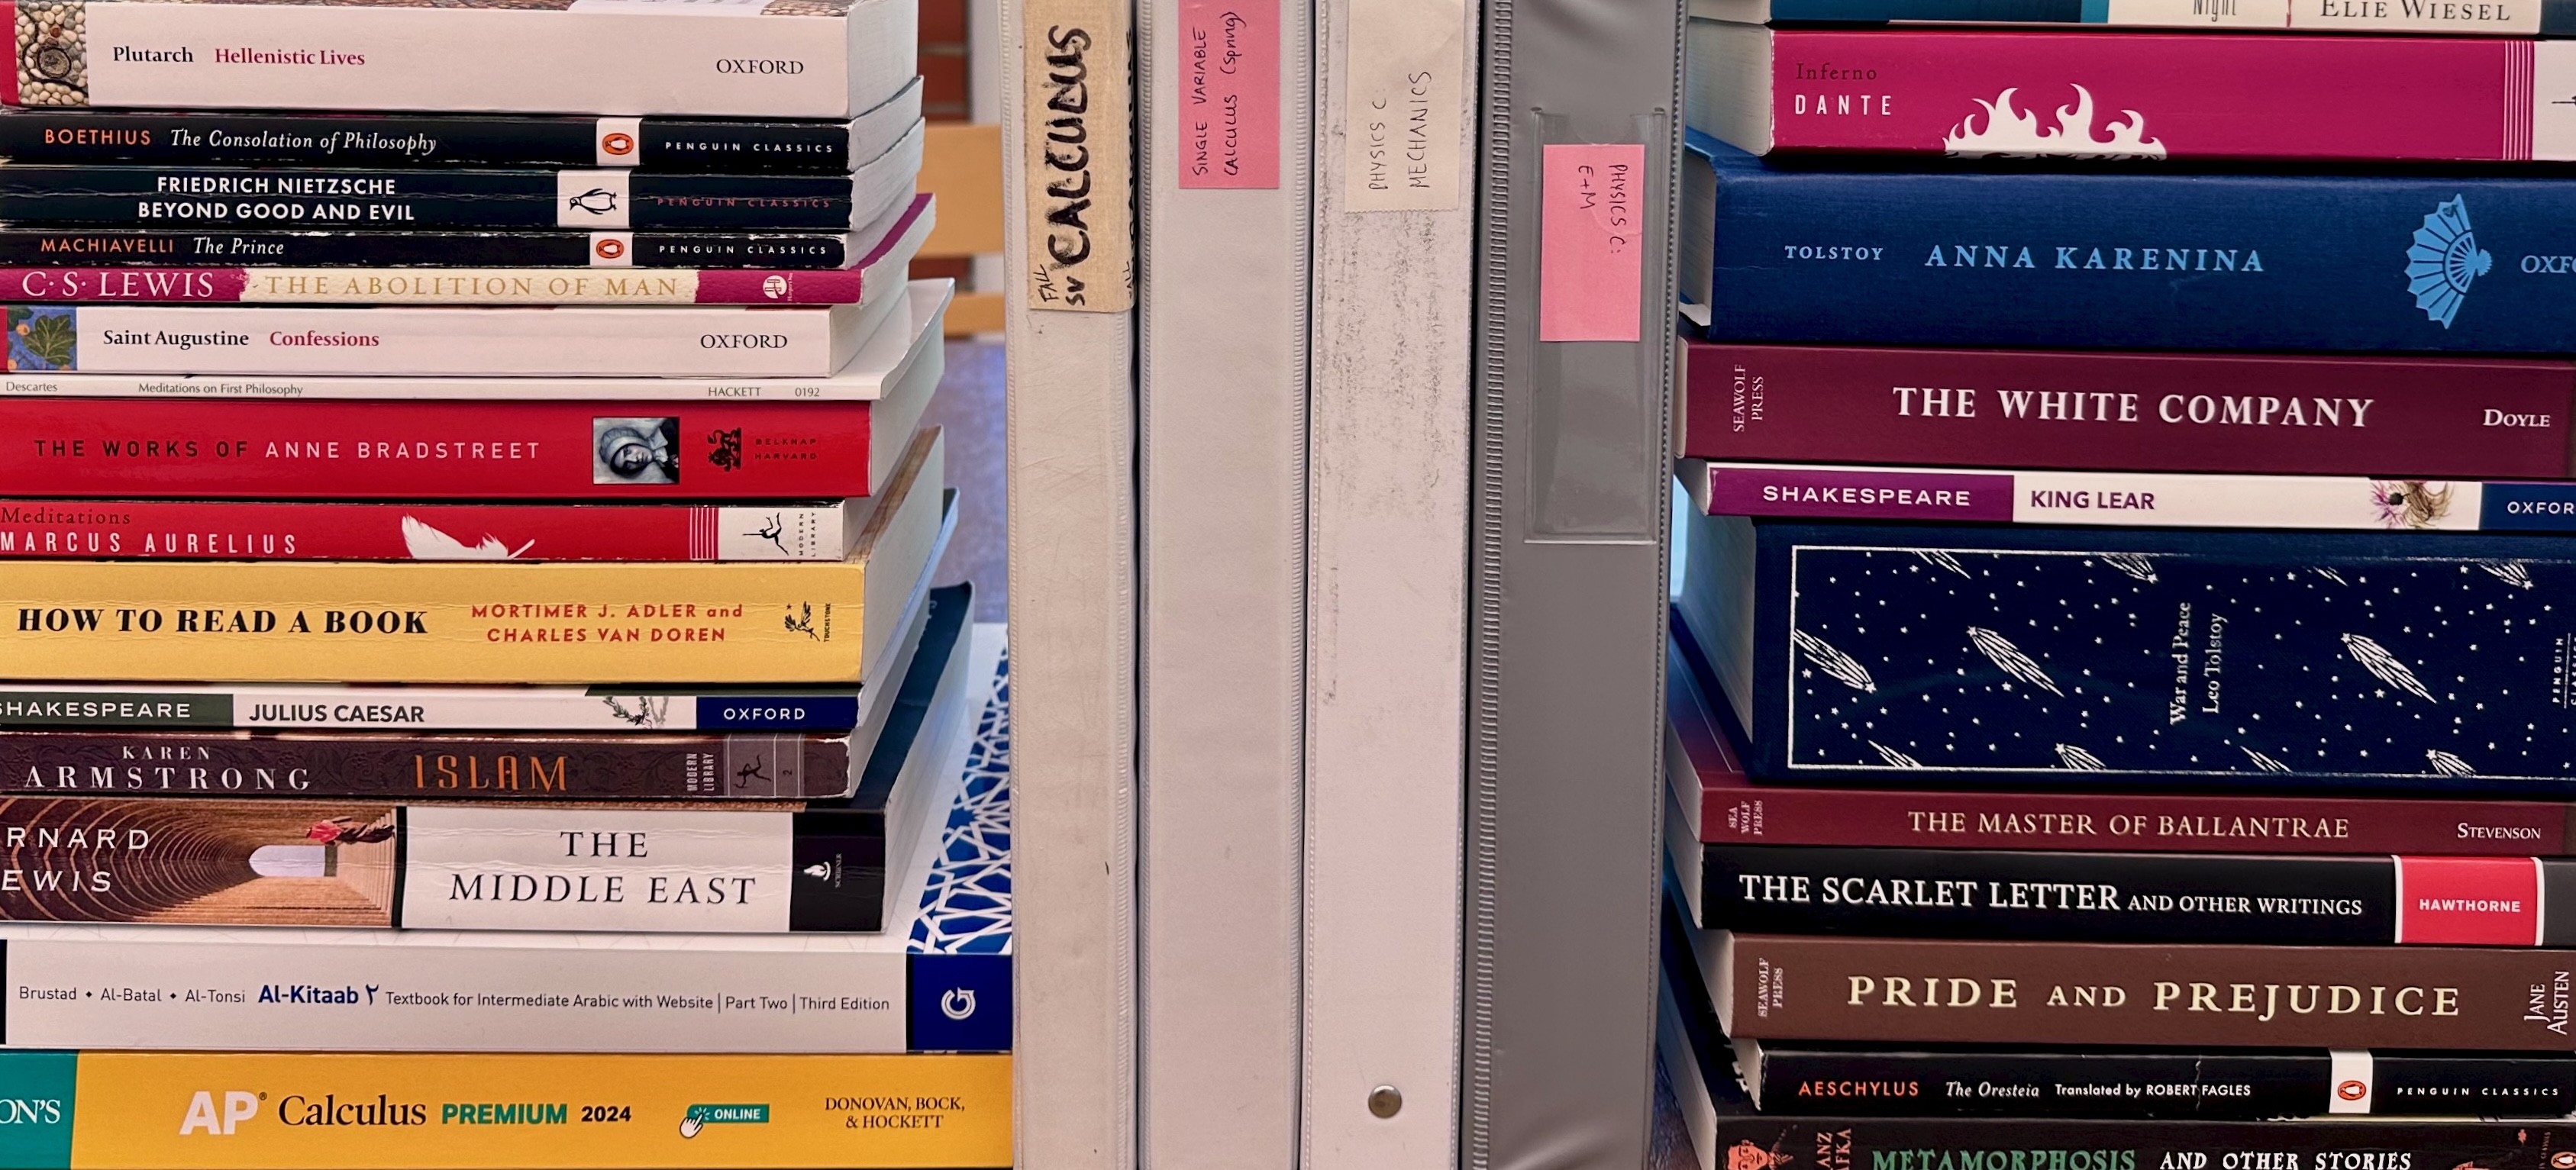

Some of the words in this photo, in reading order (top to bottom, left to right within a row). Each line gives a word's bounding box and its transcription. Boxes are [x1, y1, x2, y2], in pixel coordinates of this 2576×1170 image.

[2401, 0, 2510, 20] WIESEL
[113, 47, 194, 63] Plutarch
[215, 48, 316, 66] Hellenistic
[320, 50, 366, 66] Lives
[1192, 27, 1206, 104] VARIABLE
[1796, 63, 1877, 80] Inferno
[1795, 95, 1892, 115] DANTE
[45, 130, 150, 144] BOETHIUS
[1225, 95, 1238, 176] CALCULUS
[1406, 72, 1432, 188] MECHANICS
[172, 130, 201, 147] The
[209, 131, 312, 148] Consolation
[320, 131, 338, 153] of
[344, 132, 437, 155] Philosophy
[666, 142, 741, 150] PENGUIN
[754, 143, 833, 153] CLASSICS
[1045, 25, 1091, 269] CALCULUS
[1193, 122, 1208, 176] SINGLE
[1369, 122, 1388, 189] PHYSICS
[158, 177, 269, 194] FRIEDRICH
[278, 179, 395, 195] NIETZSCHE
[1609, 165, 1628, 226] PHYSICS
[138, 202, 228, 218] BEYOND
[236, 203, 304, 219] GOOD
[312, 205, 360, 219] AND
[370, 205, 414, 221] EVIL
[657, 198, 735, 207] PENGUIN
[748, 199, 831, 208] CLASSICS
[41, 239, 173, 253] MACHIAVELLI
[194, 237, 224, 254] The
[231, 239, 284, 255] Prince
[1785, 246, 1884, 260] TOLSTOY
[1925, 246, 2035, 269] ANNA
[2055, 247, 2264, 271] KARENINA
[99, 272, 214, 297] LEWIS
[265, 276, 328, 294] THE
[344, 276, 532, 295] ABOLITION
[548, 278, 586, 295] OF
[606, 278, 676, 295] MAN
[1033, 264, 1057, 302] FALL
[103, 330, 150, 346] Saint
[155, 330, 249, 350] Augustine
[270, 331, 379, 347] Confessions
[6, 381, 57, 393] Descartes
[138, 384, 200, 395] Meditations
[204, 385, 218, 394] on
[221, 384, 242, 395] First
[246, 384, 303, 397] Philosophy
[709, 387, 761, 397] HACKETT
[795, 387, 819, 397] 0192
[1733, 364, 1745, 432] SEAWOLF
[1751, 376, 1763, 421] PRESS
[1893, 386, 1976, 417] THE
[1997, 390, 2138, 422] WHITE
[2159, 395, 2374, 427] COMPANY
[34, 440, 85, 457] THE
[103, 440, 199, 457] WORKS
[216, 441, 248, 457] OF
[266, 441, 339, 458] ANNE
[358, 442, 539, 458] BRADSTREET
[1763, 485, 1970, 506] SHAKESPEARE
[2031, 490, 2089, 509] KING
[2098, 492, 2155, 510] LEAR
[1, 507, 131, 524] Meditations
[1, 531, 120, 552] MARCUS
[145, 533, 296, 554] AURELIUS
[18, 609, 104, 631] HOW
[116, 610, 163, 632] TO
[176, 610, 276, 633] READ
[288, 611, 309, 633] A
[324, 611, 428, 633] BOOK
[472, 604, 587, 618] MORTIMER
[597, 604, 615, 618] J.
[627, 605, 696, 618] ADLER
[707, 604, 743, 617] and
[487, 629, 587, 642] CHARLES
[597, 628, 641, 642] VAN
[651, 629, 725, 642] DOREN
[2172, 602, 2191, 649] Peace
[2203, 613, 2229, 677] Tolstoy
[2171, 653, 2188, 683] and
[2552, 638, 2564, 703] PENGUIN
[2170, 686, 2187, 725] War
[2202, 680, 2220, 714] Leo
[250, 704, 328, 722] JULIUS
[334, 705, 424, 723] CAESAR
[723, 707, 805, 720] OXFORD
[686, 753, 697, 791] MODERN
[702, 753, 715, 791] LIBRARY
[1729, 807, 1738, 828] SEA
[1741, 801, 1750, 833] WOLF
[1754, 801, 1763, 835] PRESS
[1908, 811, 1965, 833] THE
[1977, 813, 2097, 835] MASTER
[2110, 815, 2147, 835] OF
[2158, 815, 2350, 838] BALLANTRAE
[1739, 875, 1809, 902] THE
[1822, 877, 1977, 907] SCARLET
[1989, 883, 2121, 911] LETTER
[2128, 895, 2173, 911] AND
[2179, 895, 2251, 913] OTHER
[2257, 898, 2362, 915] WRITINGS
[2419, 899, 2521, 912] HAWTHORNE
[19, 986, 77, 1000] Brustad
[100, 988, 162, 1002] Al-Batal
[185, 988, 245, 1003] Al-Tonsi
[257, 985, 359, 1004] Al-Kitaab
[1758, 958, 1769, 1018] SEAWOLF
[1773, 968, 1783, 1009] PRESS
[1848, 975, 2017, 1008] PRIDE
[2047, 986, 2127, 1007] AND
[2152, 981, 2458, 1021] PREJUDICE
[386, 990, 449, 1006] Textbook
[454, 991, 472, 1006] for
[476, 992, 570, 1007] Intermediate
[573, 994, 618, 1008] Arabic
[622, 995, 653, 1008] with
[657, 994, 714, 1010] Website
[725, 997, 755, 1010] Part
[759, 998, 788, 1010] Two
[799, 997, 836, 1010] Third
[841, 997, 889, 1011] Edition
[2524, 983, 2549, 1022] JANE
[2547, 970, 2570, 1035] AUSTEN
[1798, 1081, 1919, 1097] AESCHYLUS
[1946, 1081, 1972, 1097] The
[1978, 1083, 2039, 1097] Oresteia
[2055, 1084, 2122, 1096] Translated
[2126, 1084, 2141, 1099] by
[2146, 1085, 2198, 1096] ROBERT
[2202, 1085, 2251, 1096] FAGLES
[2482, 1088, 2558, 1096] CLASSICS
[279, 1094, 426, 1126] Calculus
[441, 1104, 567, 1124] PREMIUM
[581, 1105, 631, 1122] 2024
[714, 1107, 760, 1120] ONLINE
[825, 1097, 911, 1113] DONOVAN,
[915, 1097, 965, 1113] BOCK,
[845, 1114, 859, 1129] &
[863, 1114, 943, 1129] HOCKETT
[1872, 1149, 2135, 1170] METAMORPHOSIS
